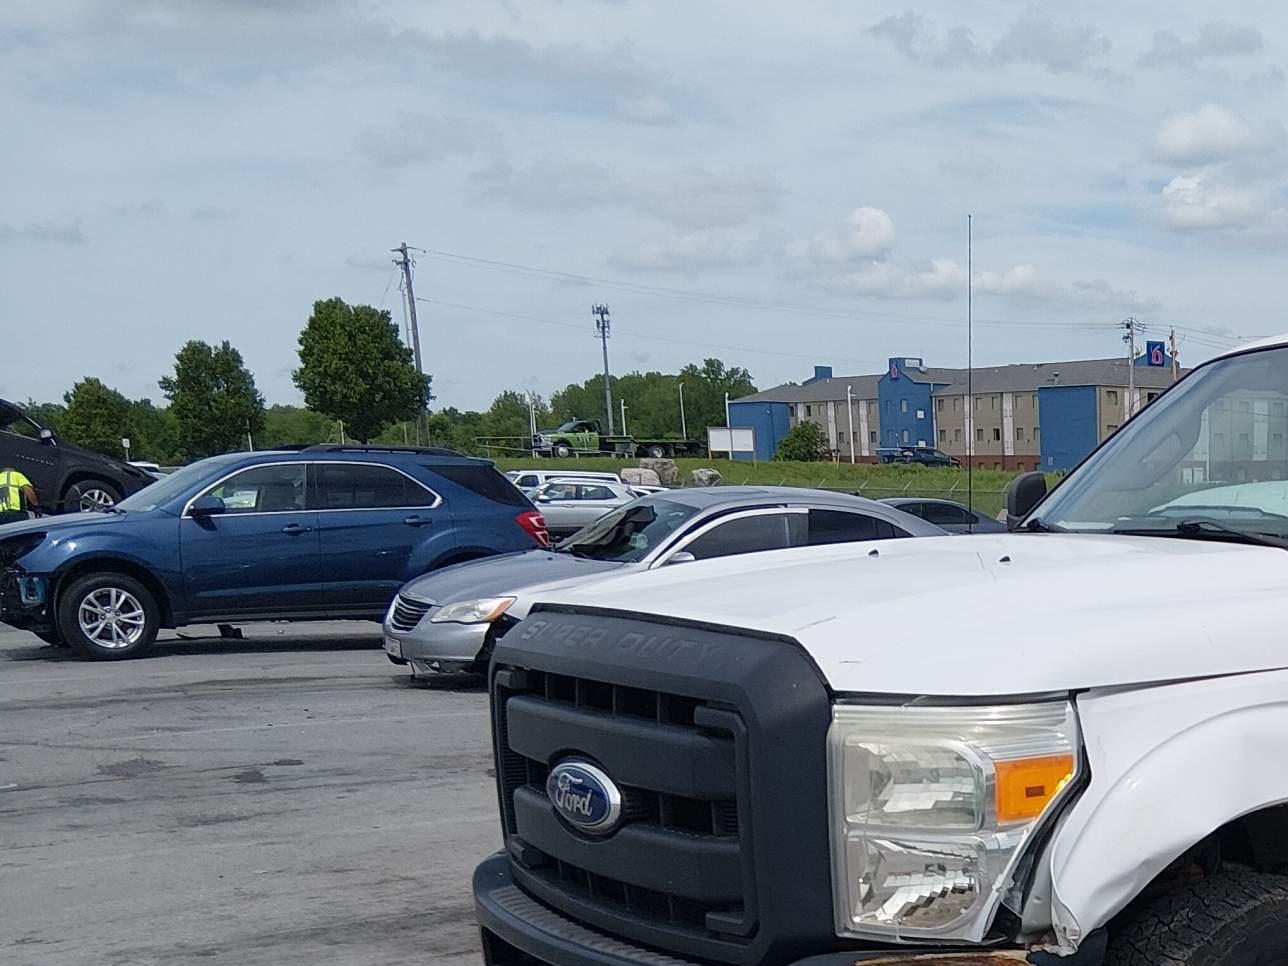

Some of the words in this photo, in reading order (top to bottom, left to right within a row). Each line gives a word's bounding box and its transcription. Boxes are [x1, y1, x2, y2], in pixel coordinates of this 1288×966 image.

[1151, 344, 1163, 365] 6
[521, 620, 609, 649] SUPER
[555, 771, 594, 816] Ford
